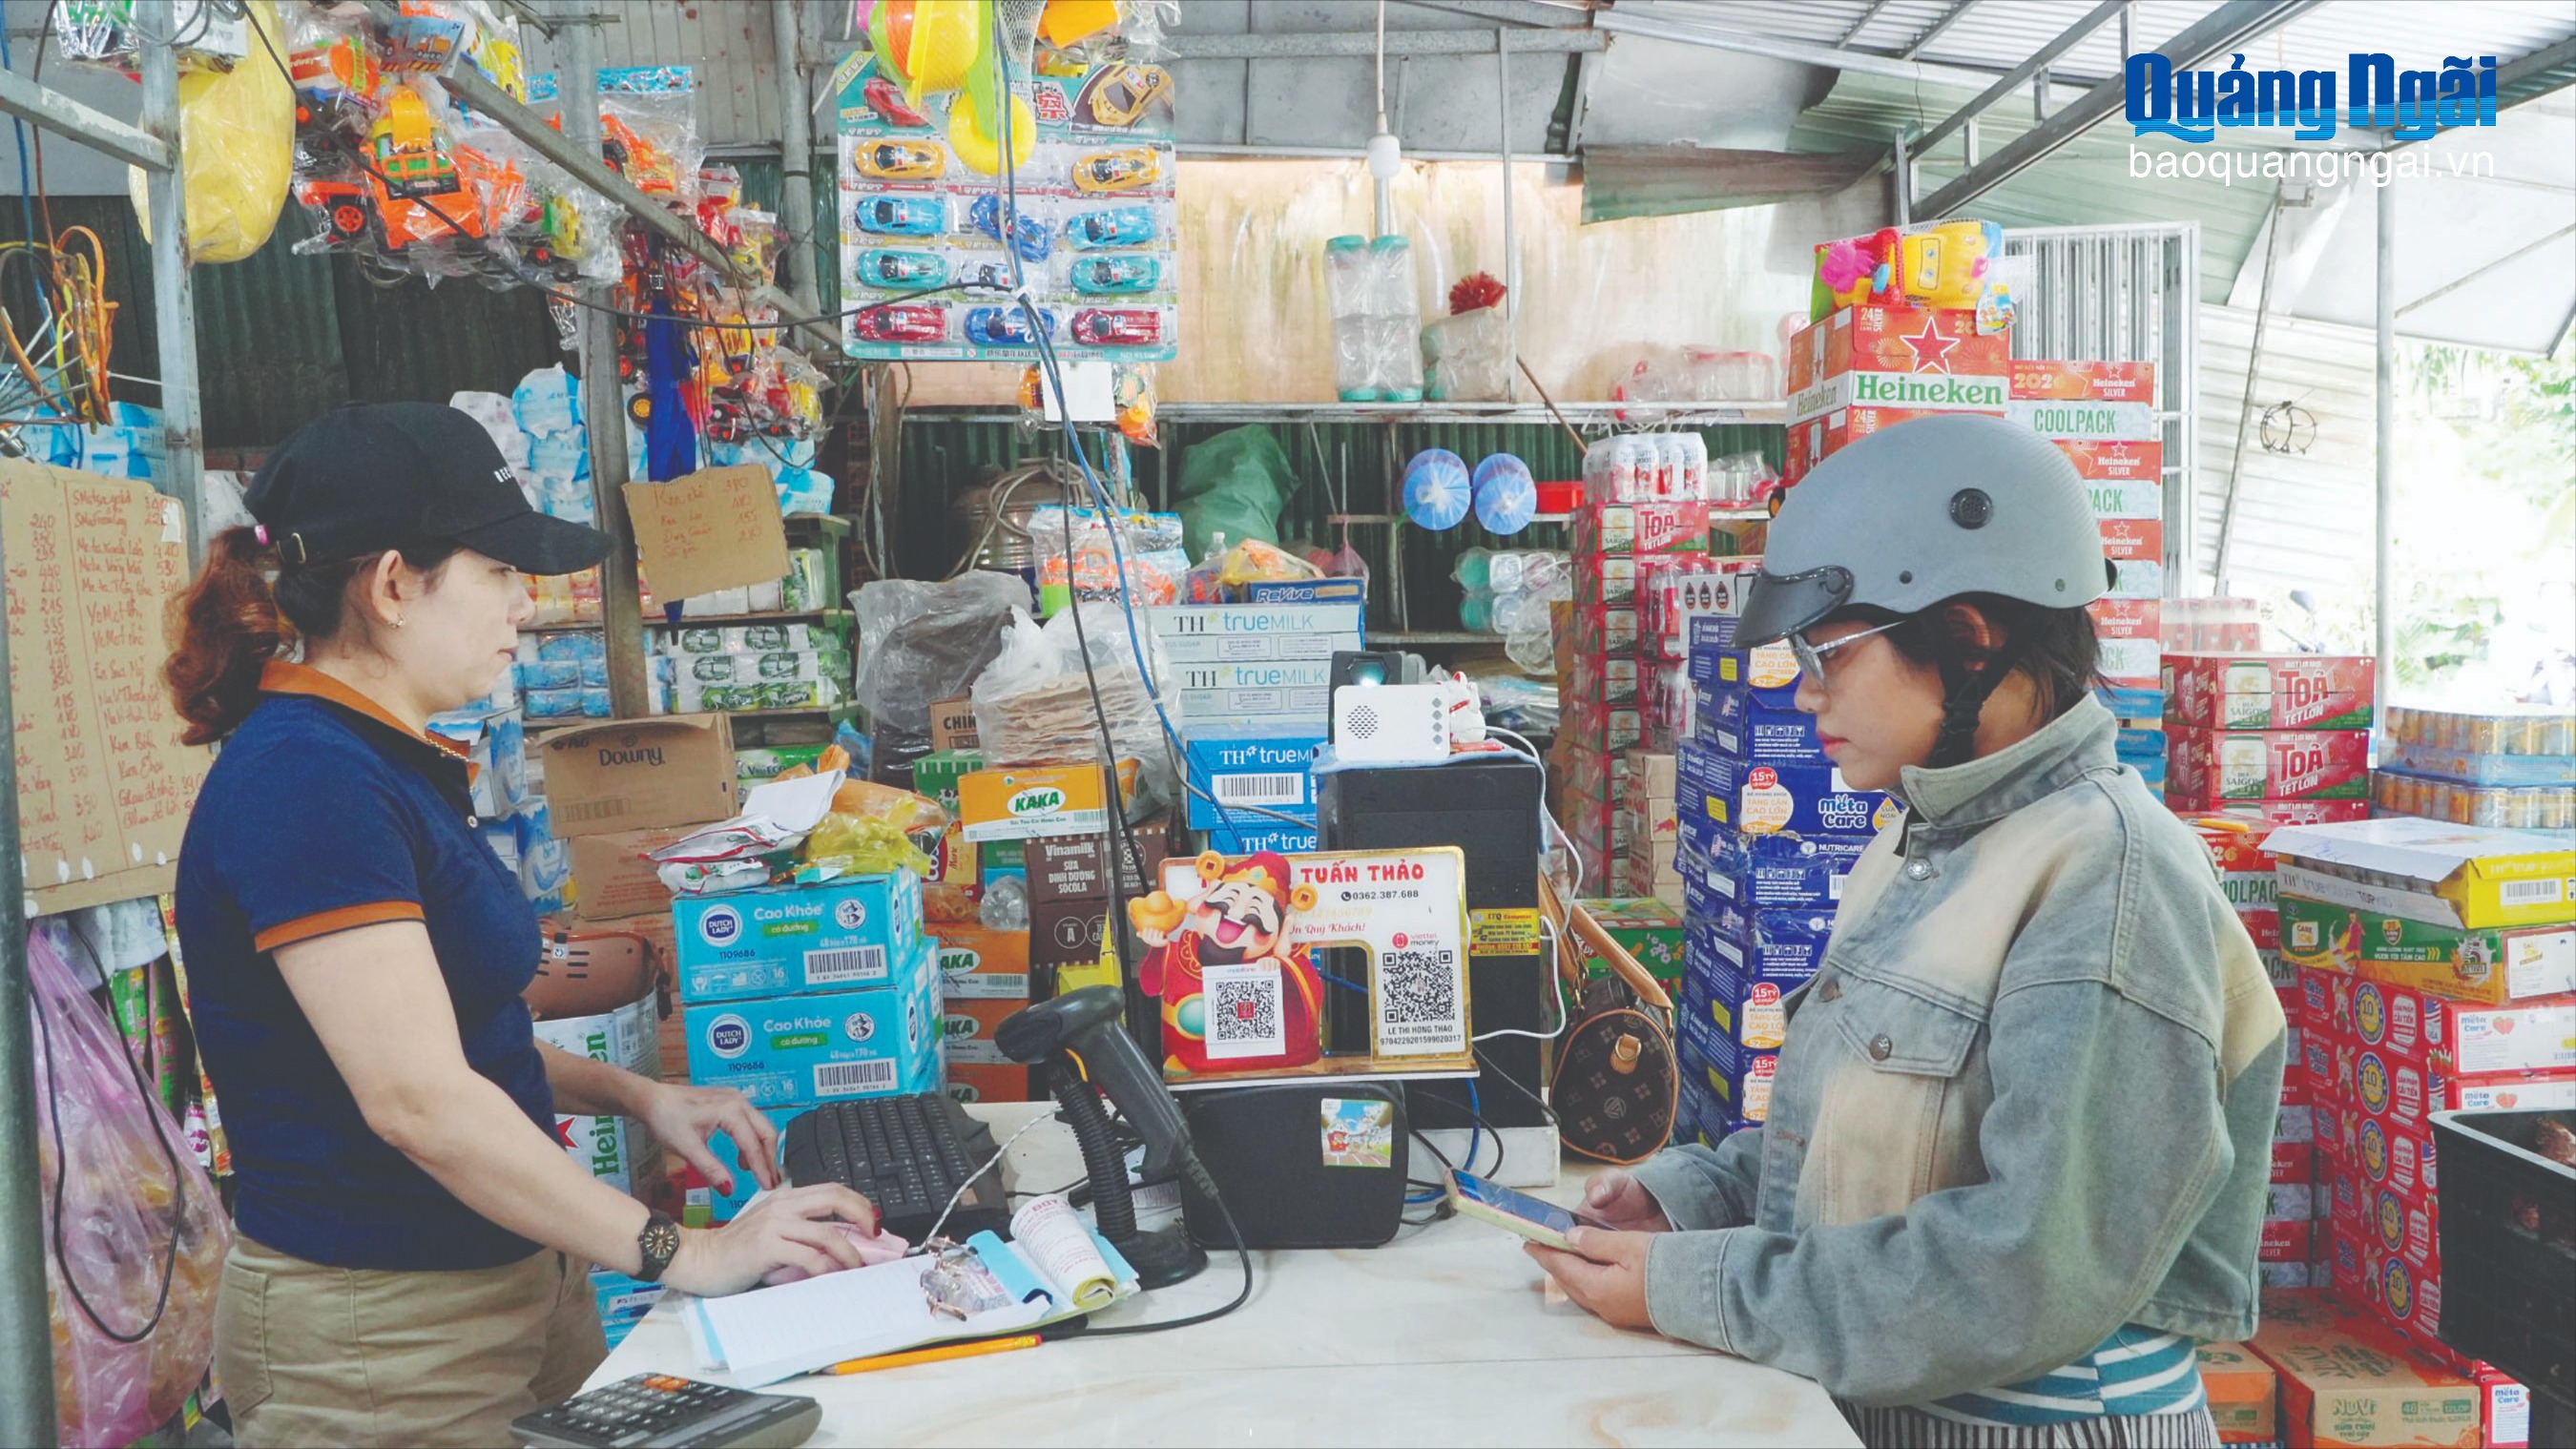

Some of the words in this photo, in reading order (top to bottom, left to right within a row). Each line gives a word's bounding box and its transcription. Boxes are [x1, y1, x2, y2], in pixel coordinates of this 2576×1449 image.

[2092, 379, 2135, 387] Heineken
[1857, 375, 2003, 404] Heineken
[2103, 387, 2127, 398] SILVER
[1797, 384, 1837, 417] Heineken
[2034, 408, 2116, 433] COOLPACK
[2097, 457, 2140, 466] Heineken
[2108, 466, 2129, 475] SILVER
[2110, 546, 2133, 555] SILVER
[1257, 587, 1315, 602] ReVive
[1174, 615, 1205, 631] TH
[2101, 616, 2142, 626] Heineken
[2111, 626, 2133, 635] SILVER
[1186, 671, 1216, 687] TH
[943, 714, 977, 732] CHIN
[599, 745, 664, 765] Downy
[1219, 750, 1244, 764] TH
[1259, 747, 1313, 763] trueMI
[1752, 771, 1764, 781] 15
[1015, 792, 1059, 812] KAKA
[1822, 814, 1867, 829] Care
[1242, 837, 1267, 852] TH
[1281, 834, 1318, 850] true
[1046, 842, 1095, 859] Vinamilk
[1300, 859, 1359, 883] TUẤN
[1367, 859, 1423, 882] THẢO
[1352, 890, 1420, 900] 0362.387.688
[754, 907, 782, 921] Cao
[709, 919, 733, 929] DUTCH
[712, 926, 732, 935] LADY
[719, 949, 756, 960] 1109686
[941, 953, 974, 969] AKA
[1755, 987, 1767, 999] 15
[763, 1018, 791, 1033] Cao
[945, 1020, 973, 1035] AKA
[1388, 1026, 1397, 1035] LE
[1412, 1025, 1432, 1034] HONG
[1433, 1025, 1452, 1033] THAO
[717, 1029, 740, 1040] DUTCH
[720, 1037, 740, 1045] LADY
[728, 1061, 764, 1071] 1109686
[1755, 1059, 1767, 1068] 15
[2259, 1238, 2290, 1247] ineken
